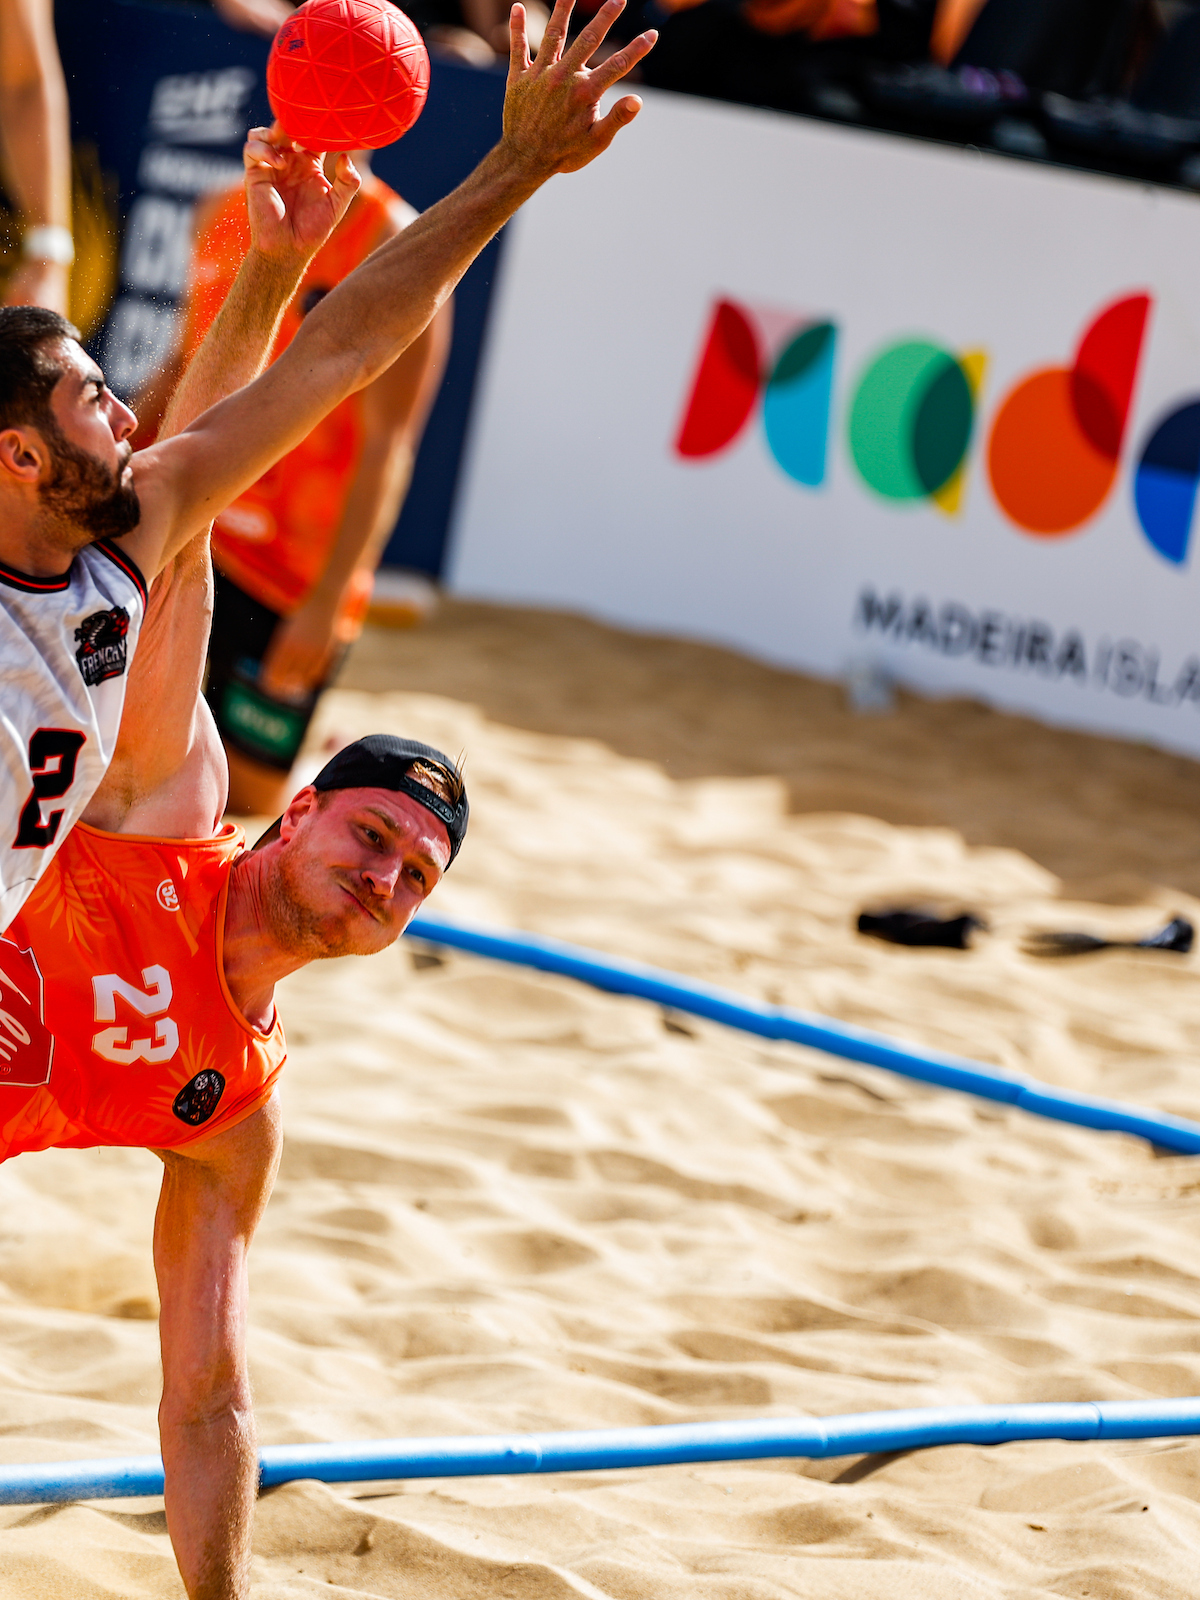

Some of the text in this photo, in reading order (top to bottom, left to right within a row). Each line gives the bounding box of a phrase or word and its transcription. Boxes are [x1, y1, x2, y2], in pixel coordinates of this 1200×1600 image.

[852, 588, 1089, 686] MADEIRA
[12, 727, 87, 850] 2
[91, 964, 180, 1067] 23
